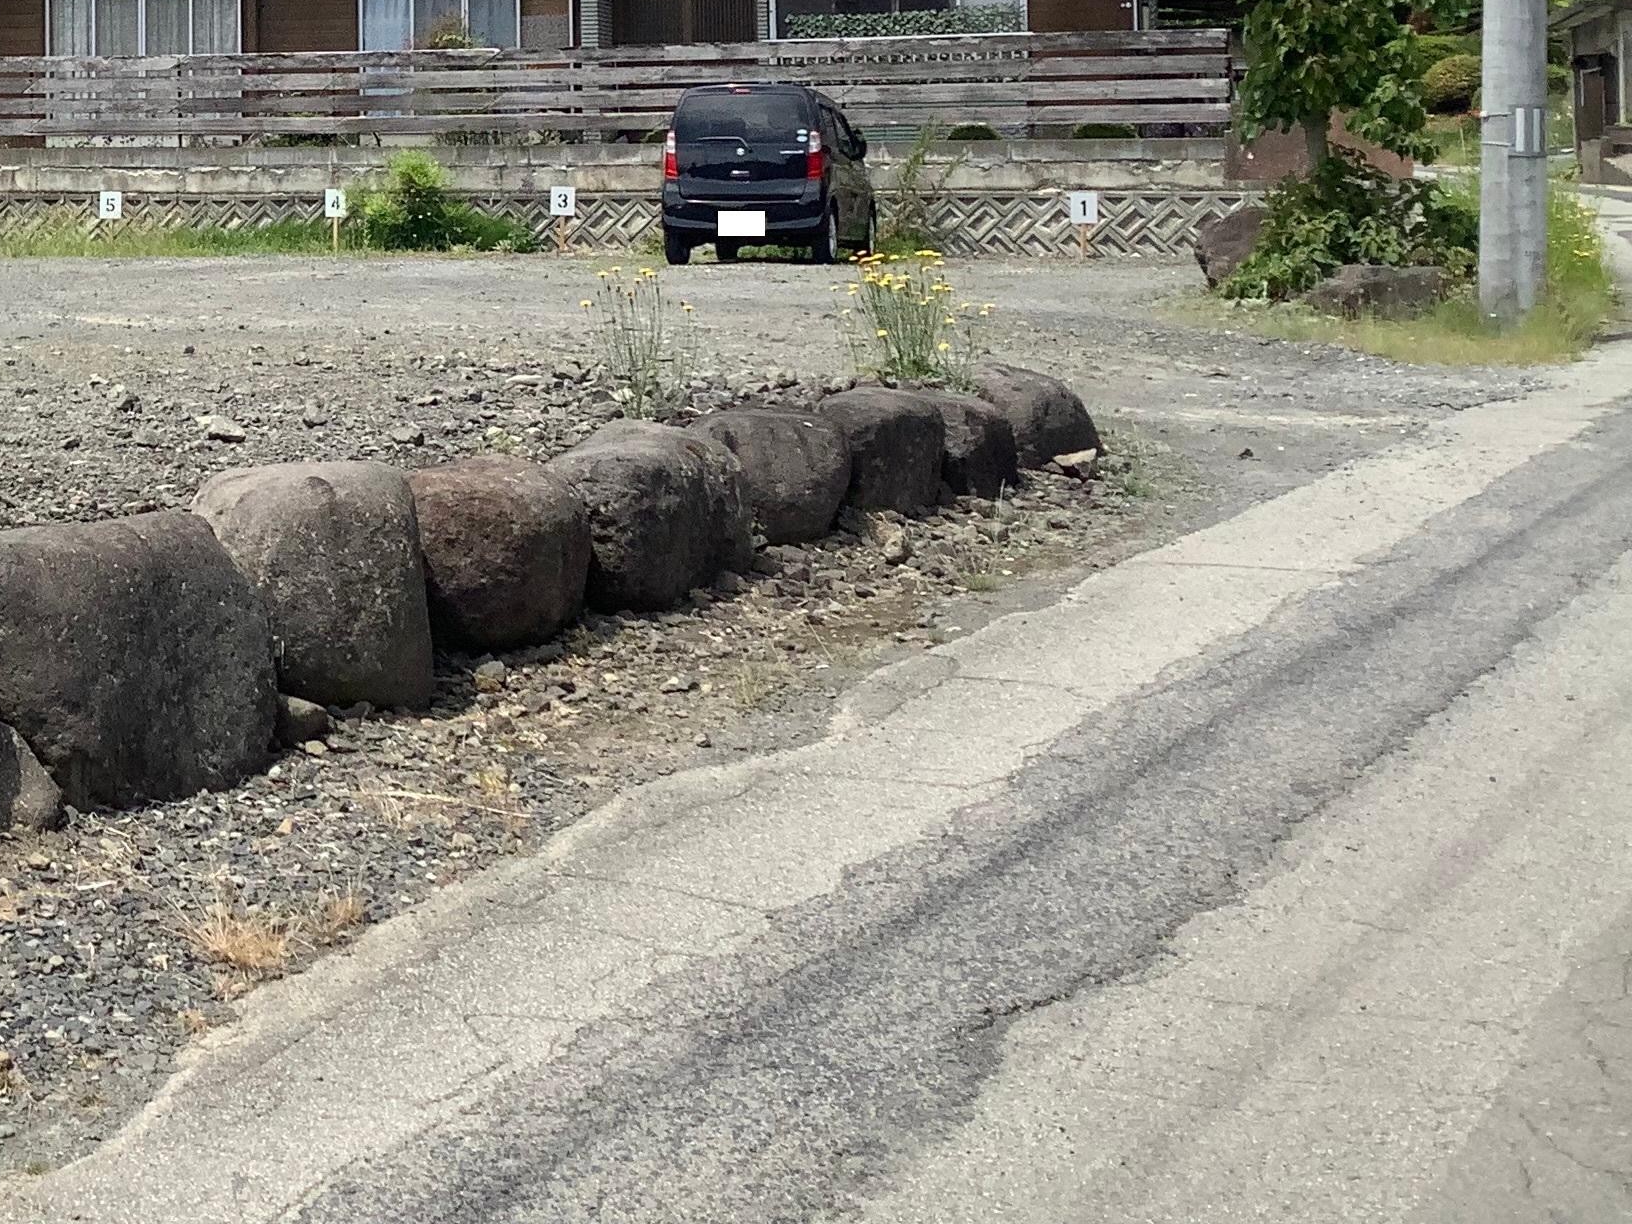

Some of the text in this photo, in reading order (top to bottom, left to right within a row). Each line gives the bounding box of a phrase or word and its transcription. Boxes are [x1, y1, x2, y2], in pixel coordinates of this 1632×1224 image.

[105, 197, 115, 212] 5
[331, 196, 340, 210] 4
[557, 193, 568, 208] 3
[1080, 200, 1088, 217] 1
